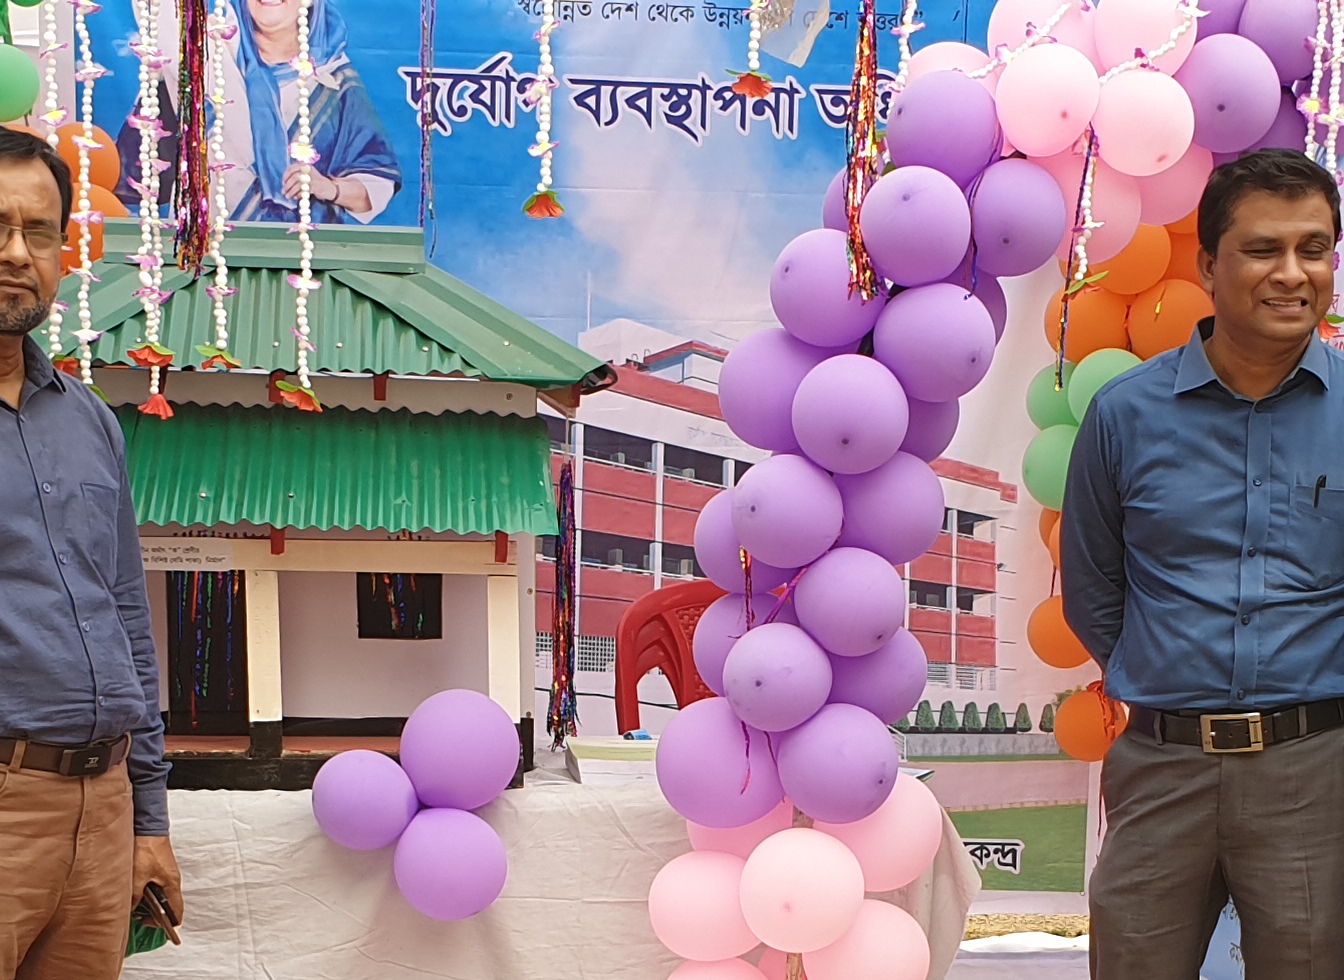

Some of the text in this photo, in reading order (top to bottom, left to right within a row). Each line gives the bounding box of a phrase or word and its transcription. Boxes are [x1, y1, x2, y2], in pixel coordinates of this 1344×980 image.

[601, 0, 639, 21] দেশ
[647, 3, 696, 23] থেকে
[568, 72, 806, 145] ব্যবস্থাপনা
[962, 838, 1025, 875] কন্দ্র
